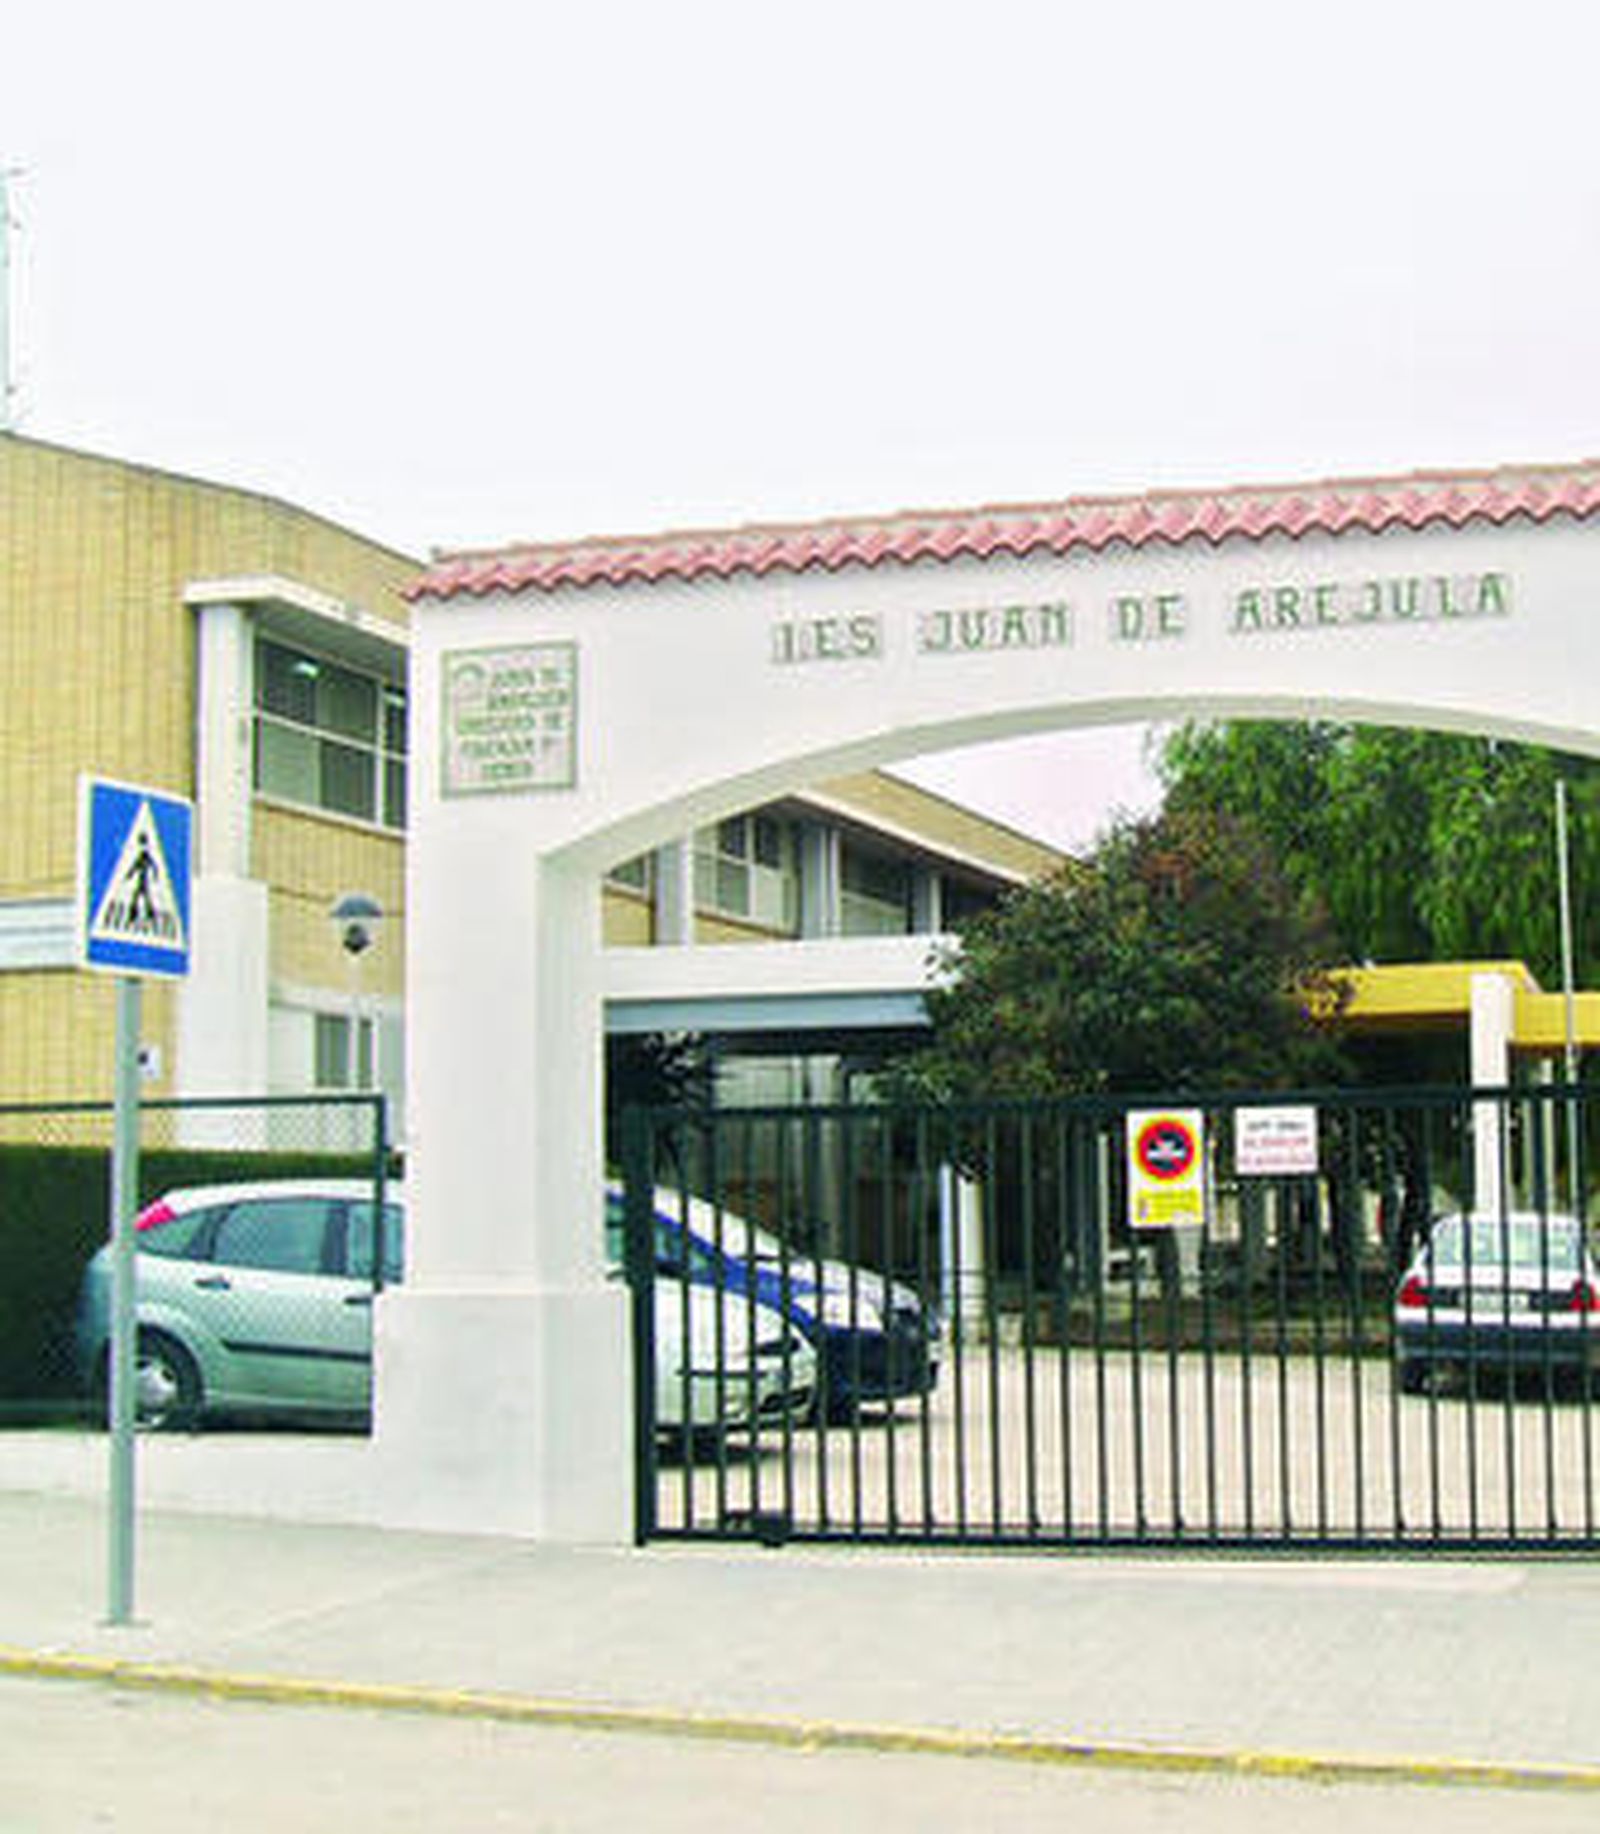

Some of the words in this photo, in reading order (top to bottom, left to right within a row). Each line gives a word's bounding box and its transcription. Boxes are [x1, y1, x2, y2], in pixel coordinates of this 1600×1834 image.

[923, 602, 1068, 650] JUAN
[1117, 595, 1184, 640] DE
[1234, 573, 1507, 634] AREJULA
